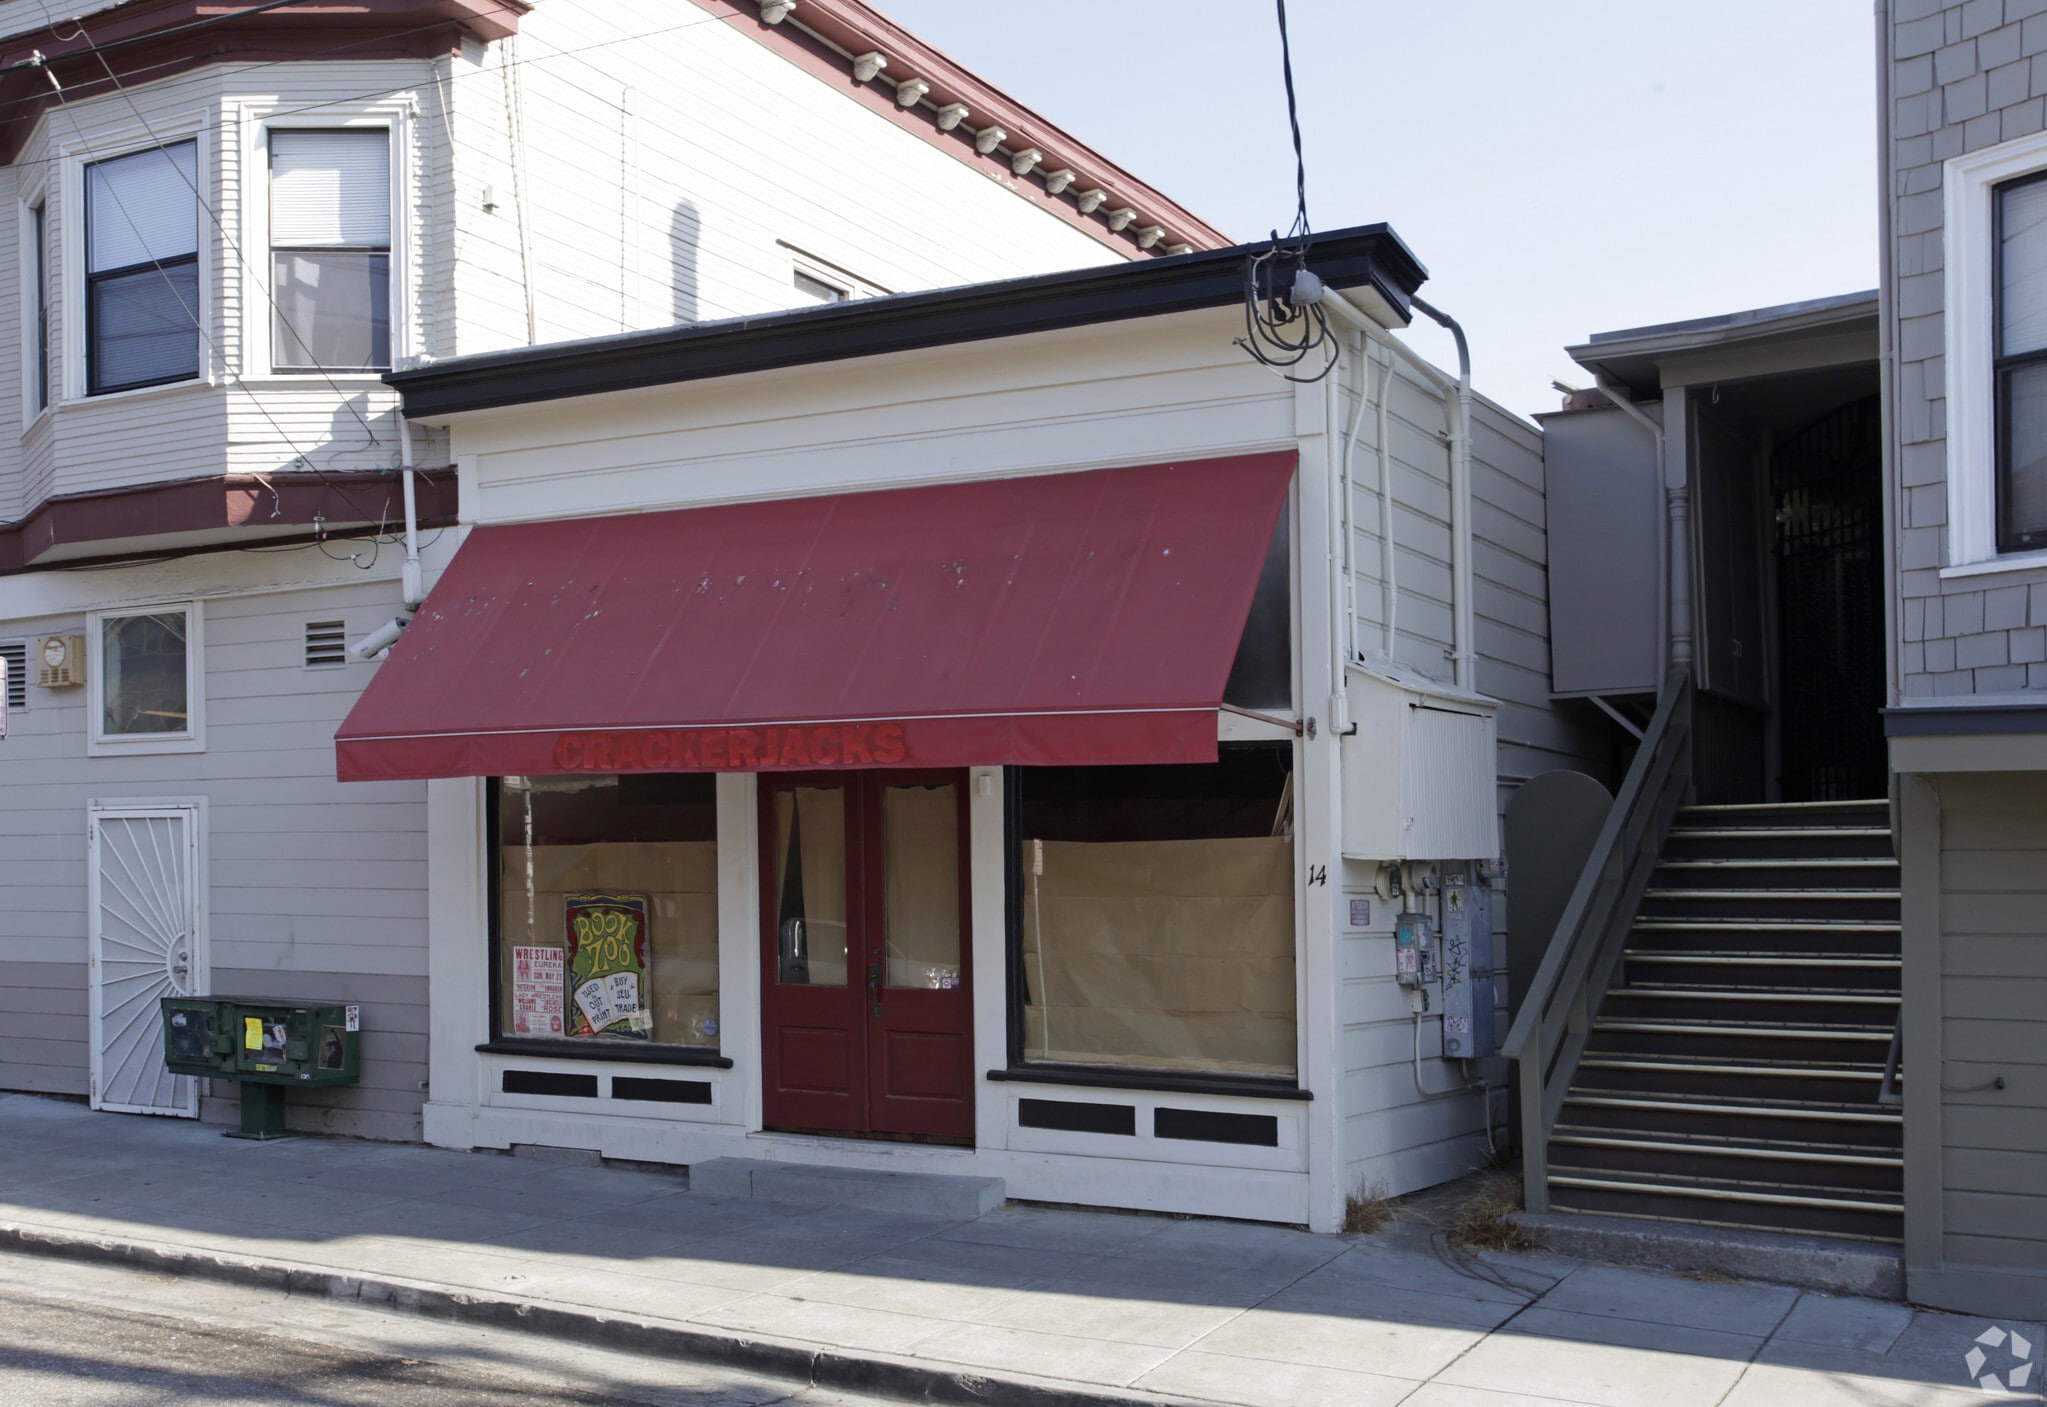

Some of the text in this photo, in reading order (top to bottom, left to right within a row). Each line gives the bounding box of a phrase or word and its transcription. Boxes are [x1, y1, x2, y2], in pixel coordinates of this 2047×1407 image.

[555, 724, 905, 769] CRACKERJACKS
[1308, 864, 1326, 887] 14
[576, 912, 633, 952] BOOK
[515, 948, 563, 961] WRESTLING
[586, 936, 630, 977] ZOO
[613, 976, 628, 987] BUY
[581, 983, 599, 998] USED
[617, 989, 630, 999] SELL
[589, 997, 603, 1010] OUT
[614, 1003, 637, 1013] TRADE
[591, 1009, 611, 1025] PRINT
